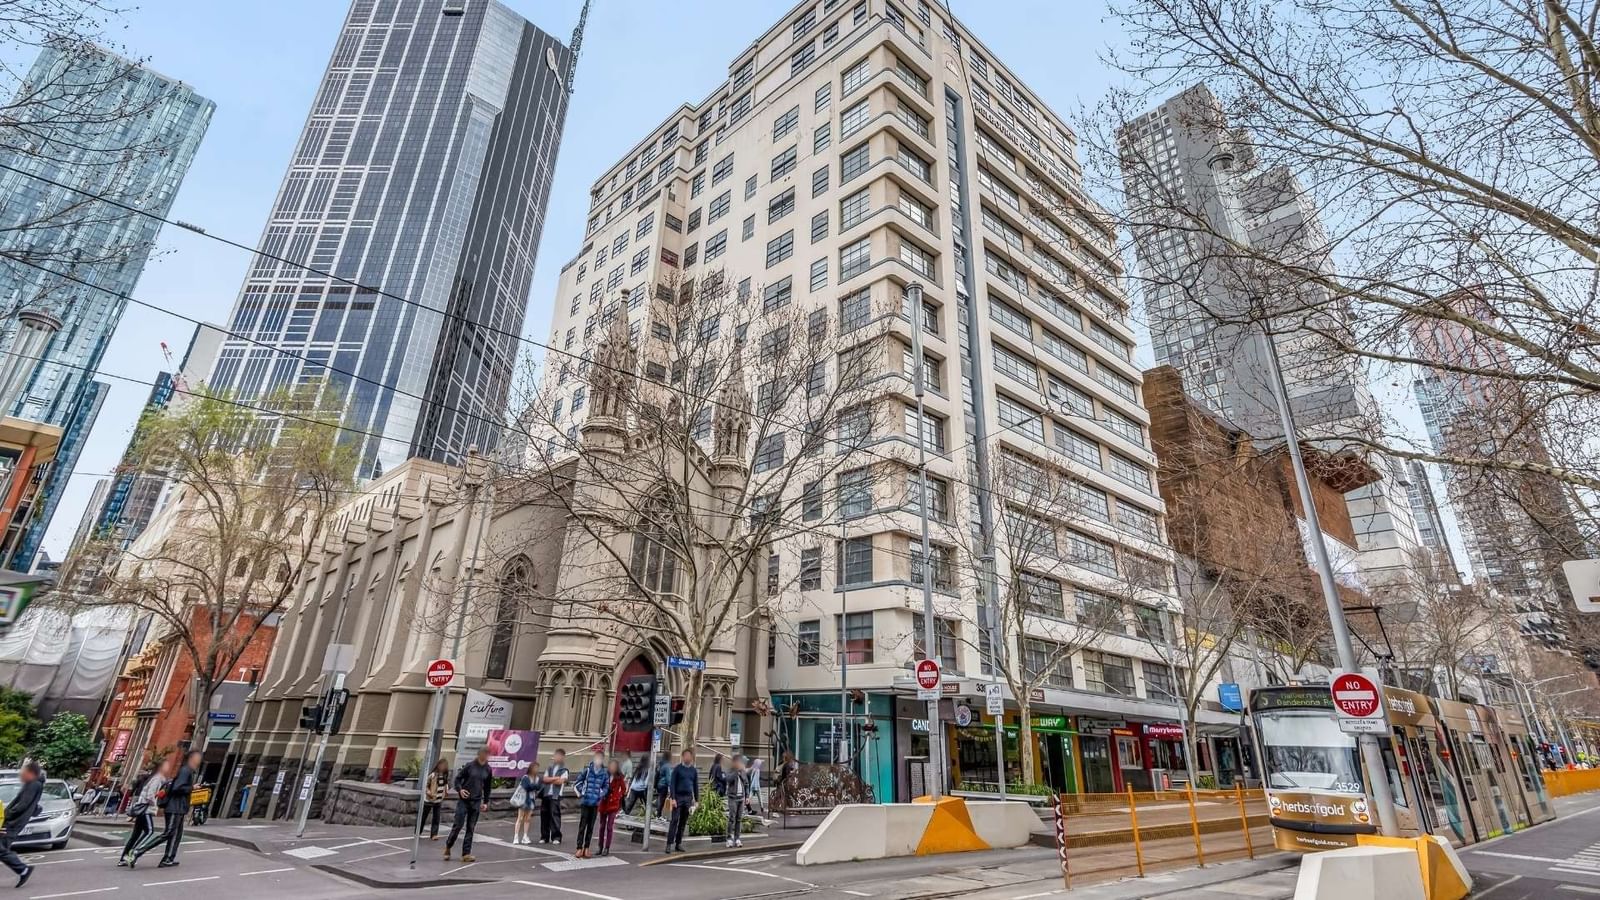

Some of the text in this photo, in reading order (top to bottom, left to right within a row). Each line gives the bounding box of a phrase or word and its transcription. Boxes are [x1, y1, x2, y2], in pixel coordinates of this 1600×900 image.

[430, 675, 450, 683] ENTRY
[1345, 681, 1360, 690] NO
[1341, 700, 1374, 711] ENTRY
[1030, 717, 1060, 727] UBWAY
[1335, 782, 1360, 792] 3529
[1282, 801, 1345, 817] herbsofgold
